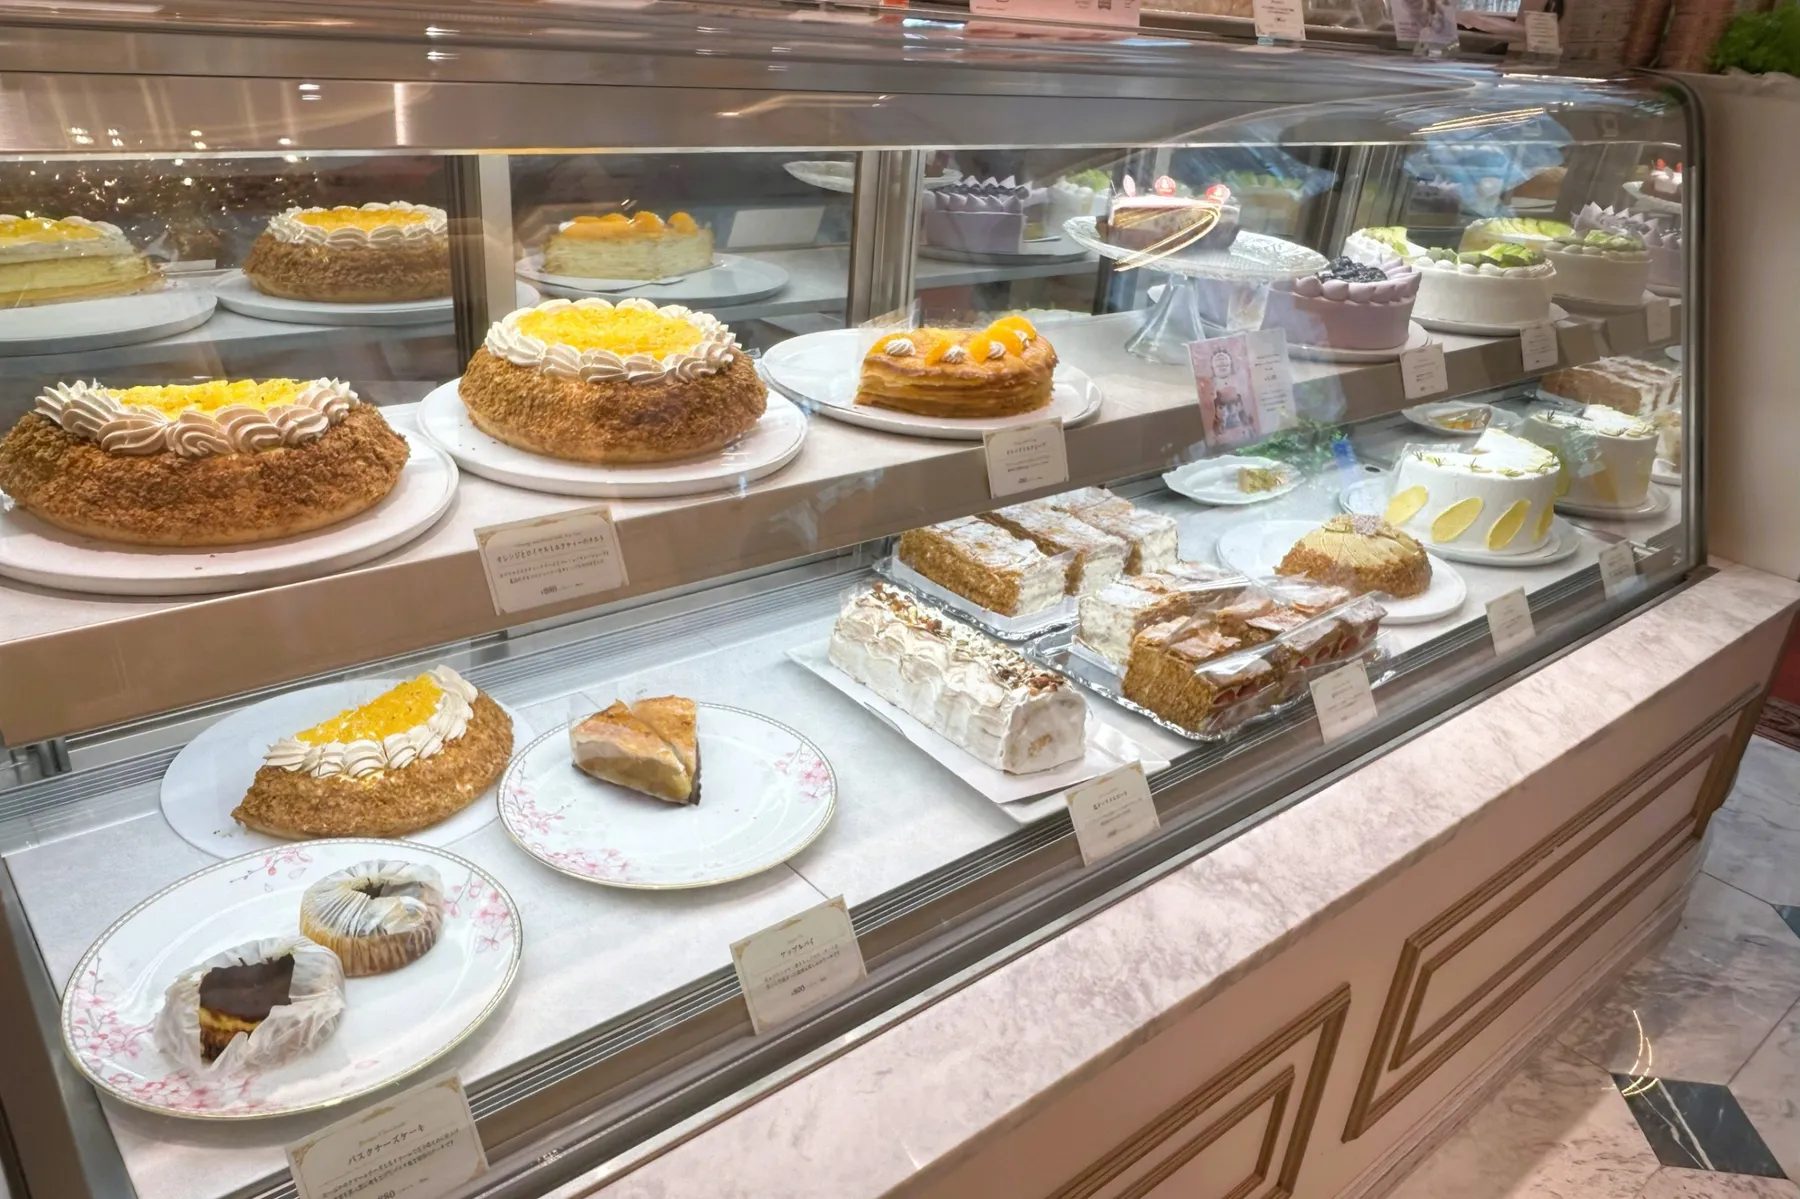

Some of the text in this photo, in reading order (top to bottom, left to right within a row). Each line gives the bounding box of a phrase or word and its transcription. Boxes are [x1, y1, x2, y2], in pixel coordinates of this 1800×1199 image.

[348, 1123, 424, 1166] バスクチーズケーキ
